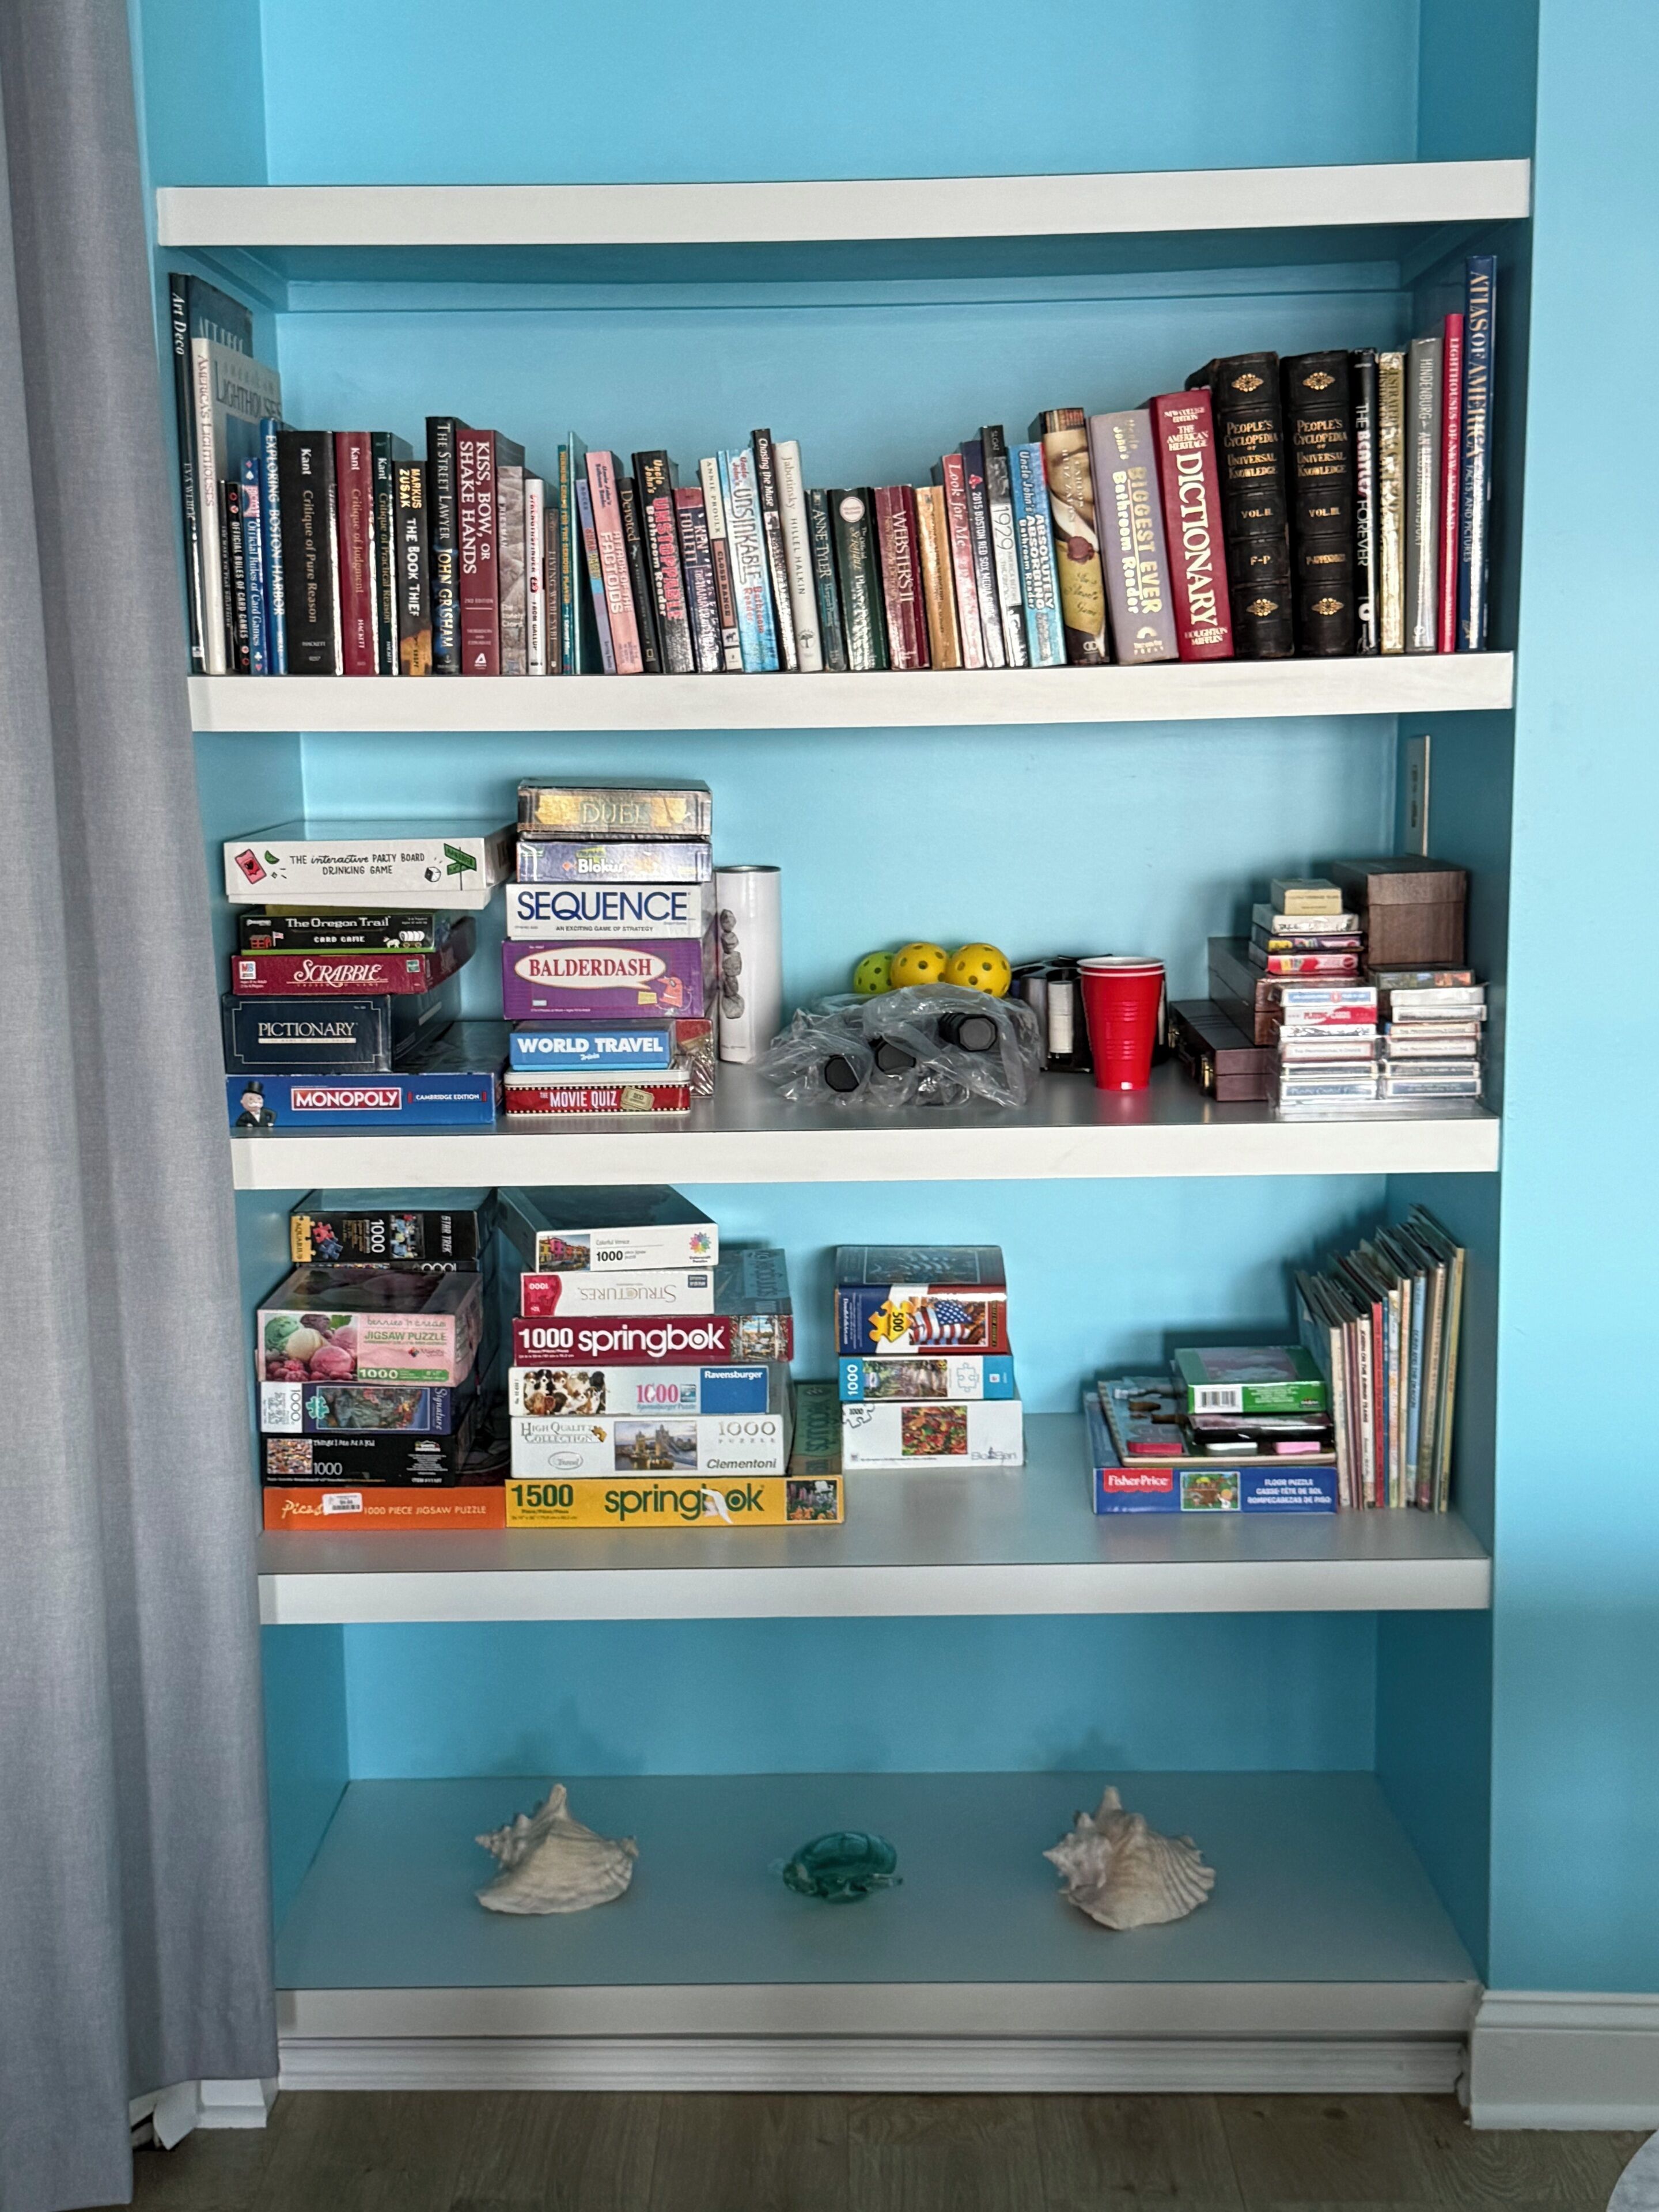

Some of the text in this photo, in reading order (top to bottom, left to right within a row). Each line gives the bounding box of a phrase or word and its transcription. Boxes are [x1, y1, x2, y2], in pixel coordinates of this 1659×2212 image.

[1470, 272, 1490, 331] ATLAS
[172, 293, 187, 355] Art Deco
[1471, 333, 1486, 359] OF
[1418, 358, 1434, 419] HINDENBURG
[1448, 338, 1459, 420] LIGHTHOUSES
[1226, 419, 1274, 435] PEOPLE'S
[1297, 418, 1343, 433] PEOPLE'S
[1467, 361, 1487, 458] AMERICA
[1166, 430, 1209, 444] AMERICAN
[1168, 439, 1209, 452] HERITAGE
[1224, 432, 1278, 448] CYCLOPEDIA
[1294, 431, 1347, 446] CYCLOPEDIA
[201, 422, 215, 506] LIGHTHOUSES
[266, 435, 280, 502] EXPLORING
[301, 448, 312, 475] Kant
[350, 447, 361, 471] Kant
[378, 457, 387, 480] Kant
[653, 460, 665, 485] Uncle
[757, 438, 774, 507] Chasing Muse
[1227, 452, 1277, 466] UNIVERSAL
[1229, 465, 1279, 479] KNOWLEDGE
[1297, 450, 1347, 464] UNIVERSAL
[1297, 464, 1347, 478] KNOWLEDGE
[399, 468, 411, 508] ZUSAK
[411, 468, 422, 509] MARKUS
[437, 423, 453, 540] THE STREET LAWYER
[644, 465, 657, 494] John's
[948, 464, 965, 497] Look
[1018, 451, 1035, 514] Uncle John's
[1355, 402, 1369, 567] THE FOREVER
[460, 441, 477, 574] SHAKE HANDS
[476, 441, 492, 560] KISS, BOW, OR
[622, 490, 641, 542] Devoted
[953, 501, 968, 520] for
[269, 510, 282, 558] BOSTON
[351, 489, 364, 593] Critique Judgment
[680, 513, 698, 564] FOLLETT
[781, 457, 806, 596] Jabotinsky HILLEL HALKIN
[812, 509, 832, 579] ANNE TYLER
[955, 524, 968, 548] Me
[972, 491, 993, 593] 2015 BOSTON RED SOX MEDIA
[993, 505, 1014, 552] 1929
[1112, 471, 1139, 614] Bathroom Reader
[1127, 466, 1162, 615] BIGGEST EVER
[1176, 450, 1218, 626] DICTIONARY
[1463, 497, 1474, 563] AND PICTURES
[302, 490, 318, 623] Critique Pure Reason
[378, 493, 391, 623] Critique Practical Reason
[406, 517, 421, 617] THE BOOK THIEF
[613, 530, 627, 573] ATTACK
[646, 506, 666, 616] Bathroom Reader
[652, 497, 684, 620] UNSTOPPABLE
[892, 510, 914, 591] WEBSTER'S
[1025, 515, 1044, 611] ABSORBING
[1033, 514, 1055, 609] ABSOLUTELY
[231, 521, 249, 639] OFFICIAL RULES CARD GAMES
[247, 521, 262, 646] Official Card Games
[272, 565, 285, 615] HARBOR
[601, 532, 624, 615] FACTOIDS
[1024, 572, 1036, 609] Reader
[438, 548, 454, 647] JOHN GRISHAM
[743, 587, 753, 623] Reader
[753, 586, 764, 634] Bathroom
[582, 802, 646, 824] DUEL
[290, 853, 425, 864] THE interactive PARTY BOARD
[322, 865, 393, 876] DRINKING GAME
[286, 918, 309, 929] The
[311, 918, 355, 929] Oregon
[357, 916, 389, 927] Trail
[517, 891, 688, 921] SEQUENCE
[293, 959, 382, 988] SCRABBLE
[529, 959, 652, 976] BALDERDASH
[258, 1022, 355, 1036] PICTIONARY
[517, 1038, 663, 1054] WORLD TRAVEL
[296, 1090, 398, 1107] MONOPOLY
[550, 1090, 617, 1108] MOVIE QUIZ
[370, 1218, 385, 1253] 1000
[441, 1215, 452, 1256] STAR TREK
[596, 1250, 623, 1262] 1000
[580, 1284, 677, 1303] STRUCTURES
[365, 1331, 447, 1341] JIGSAW PUZZLE
[893, 1312, 904, 1332] 500
[518, 1323, 725, 1358] 1000 springbok
[358, 1369, 399, 1379] 1000
[704, 1370, 763, 1381] Ravensburger
[846, 1363, 859, 1396] 1000
[290, 1388, 301, 1422] 1000
[435, 1387, 448, 1431] Signature
[636, 1383, 679, 1403] 1000
[521, 1422, 548, 1436] HIGH
[719, 1421, 776, 1436] 1000
[313, 1462, 343, 1475] 1000
[707, 1458, 777, 1469] Clementoni
[364, 1505, 487, 1515] 1000 PIECE JIGSAW PUZZLE
[511, 1484, 574, 1508] 1500
